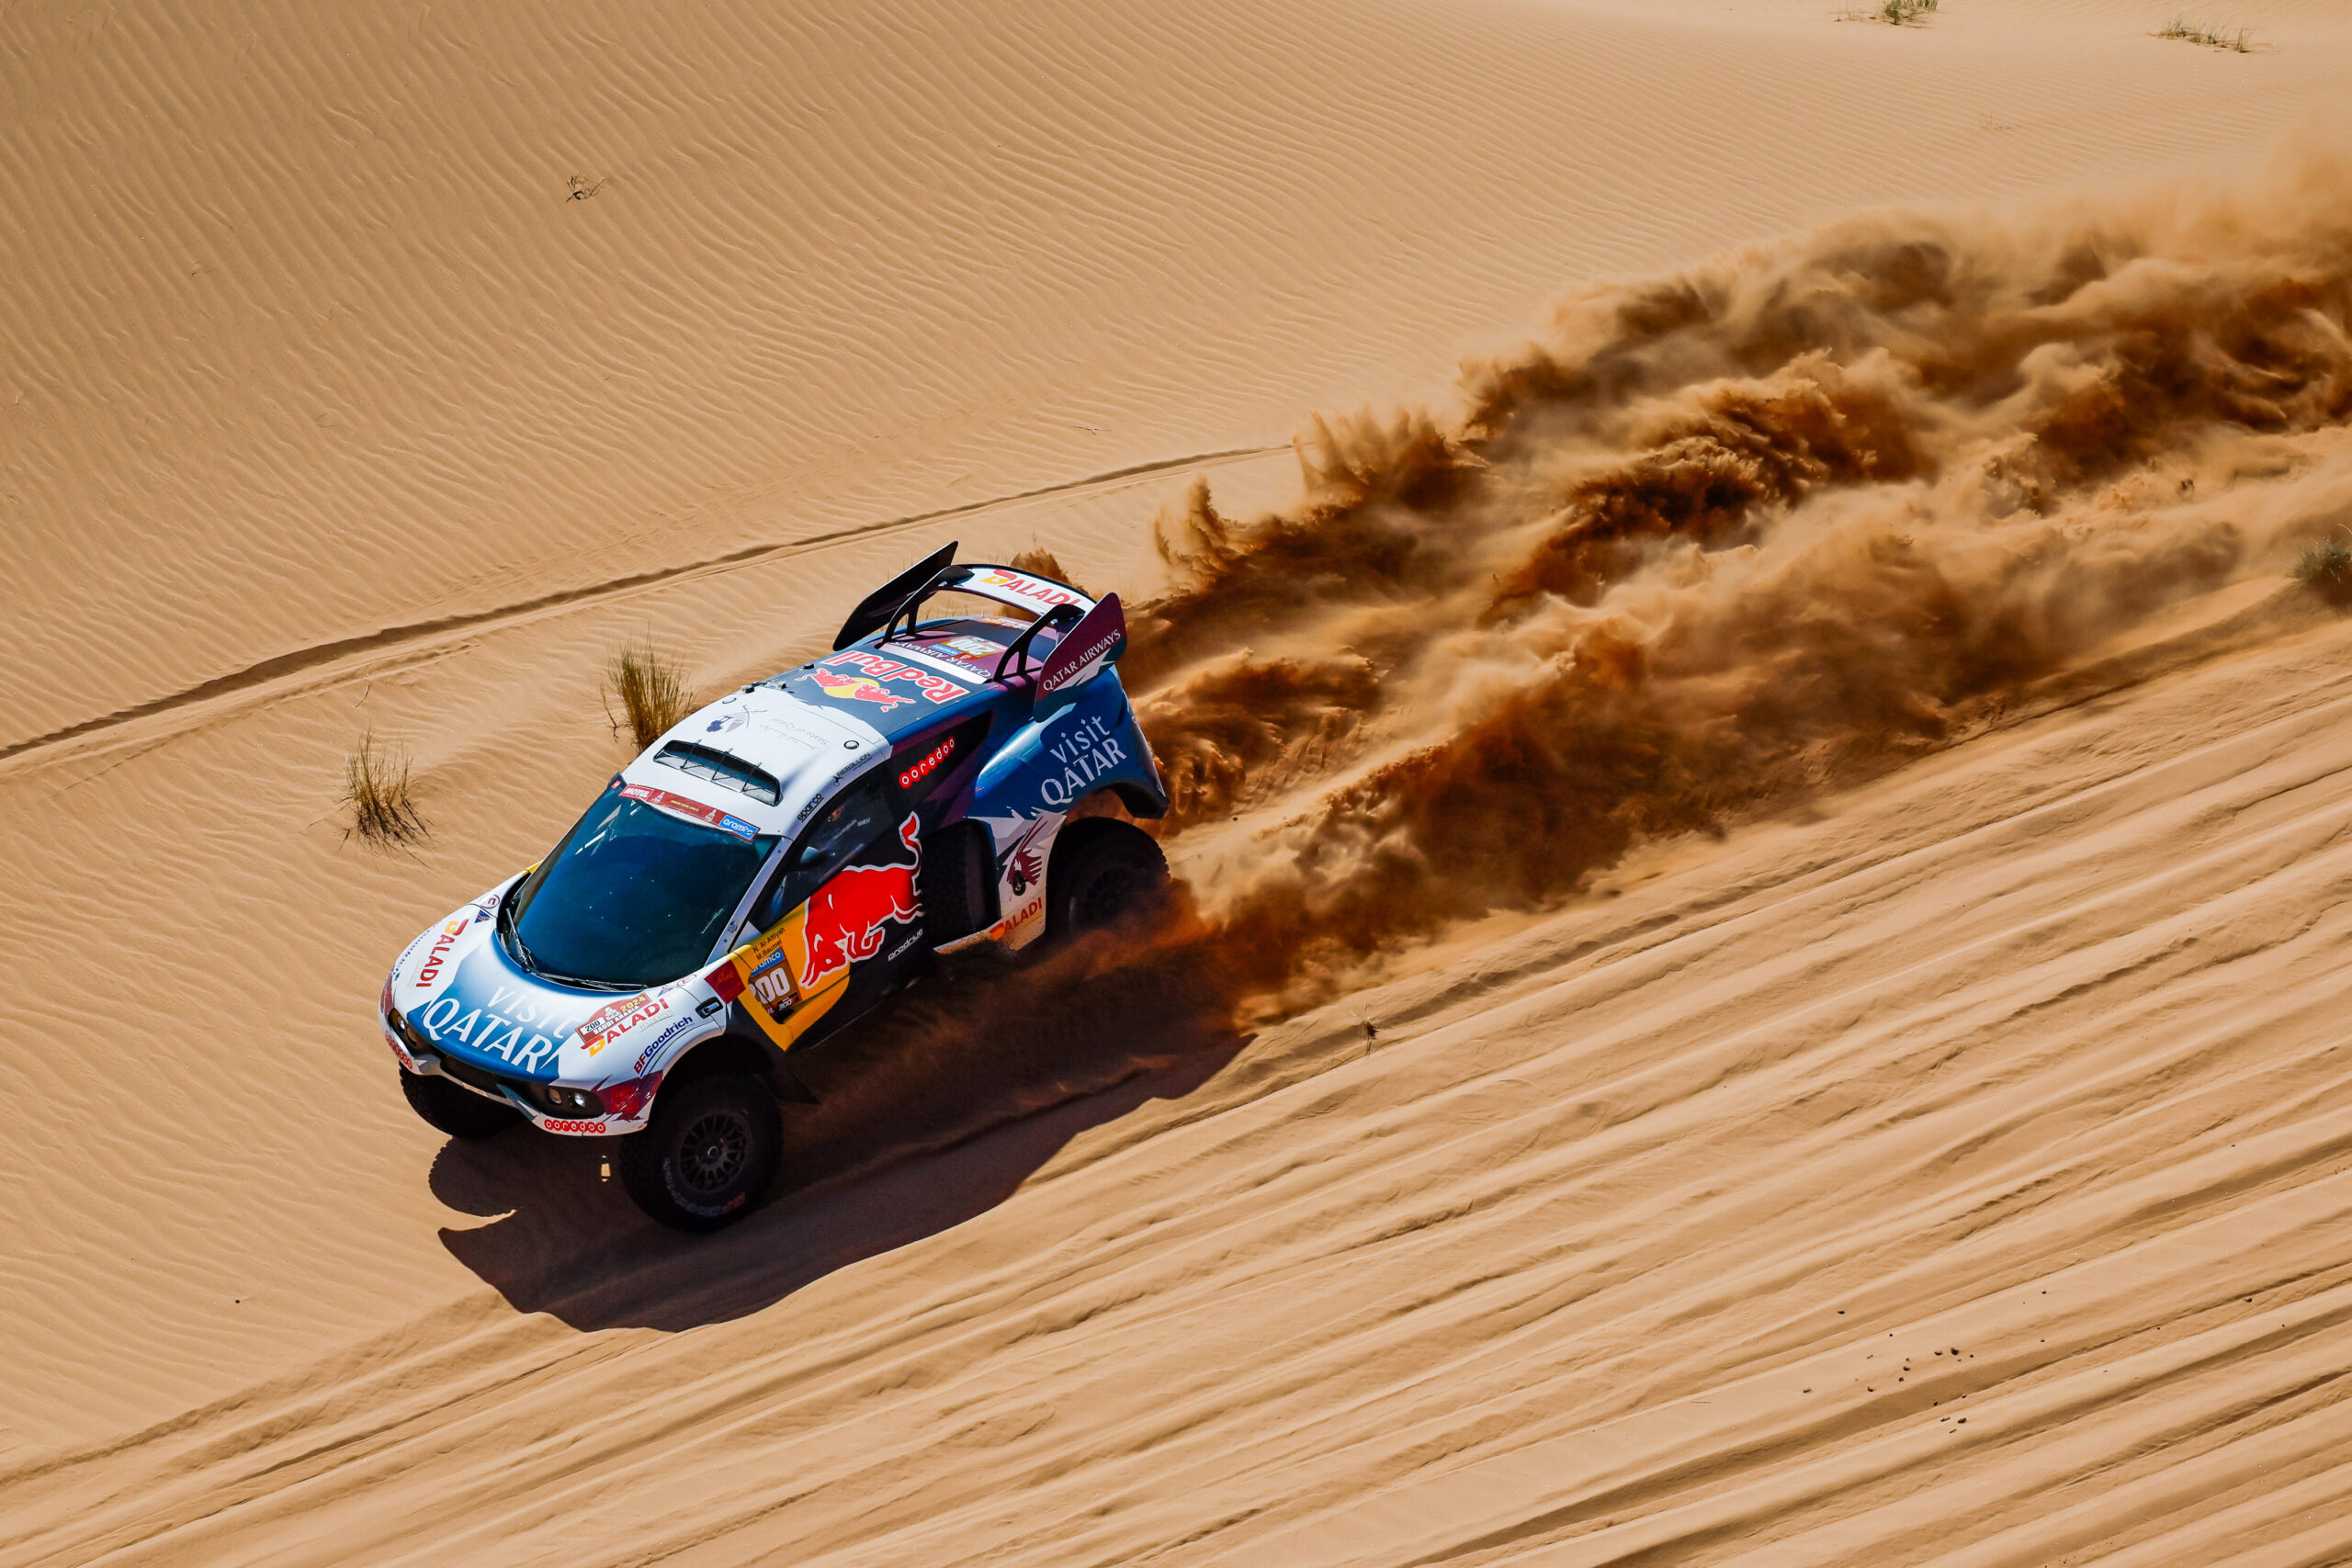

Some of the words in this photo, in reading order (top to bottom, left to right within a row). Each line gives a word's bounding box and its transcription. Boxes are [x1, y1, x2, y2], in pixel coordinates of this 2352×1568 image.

[979, 569, 1081, 605] BALADI
[946, 654, 992, 677] QATAR
[1043, 660, 1079, 691] QATAR
[1079, 628, 1121, 667] AIRWAYS
[1049, 715, 1110, 763] visit
[900, 738, 956, 786] ooredoo
[1041, 738, 1127, 806] QATAR
[623, 786, 650, 799] MOTUL
[797, 793, 823, 821] sparco
[722, 818, 754, 836] aramco
[989, 897, 1043, 941] BALADI
[415, 919, 469, 987] BALADI
[593, 1021, 614, 1034] SAUDI
[614, 1005, 640, 1024] ARABIA
[620, 996, 646, 1012] 2024
[423, 998, 554, 1075] QATAR
[581, 998, 670, 1057] BALADI
[585, 1020, 602, 1032] 200
[633, 1015, 694, 1075] BFGoodrich
[545, 1120, 605, 1133] ooredoo
